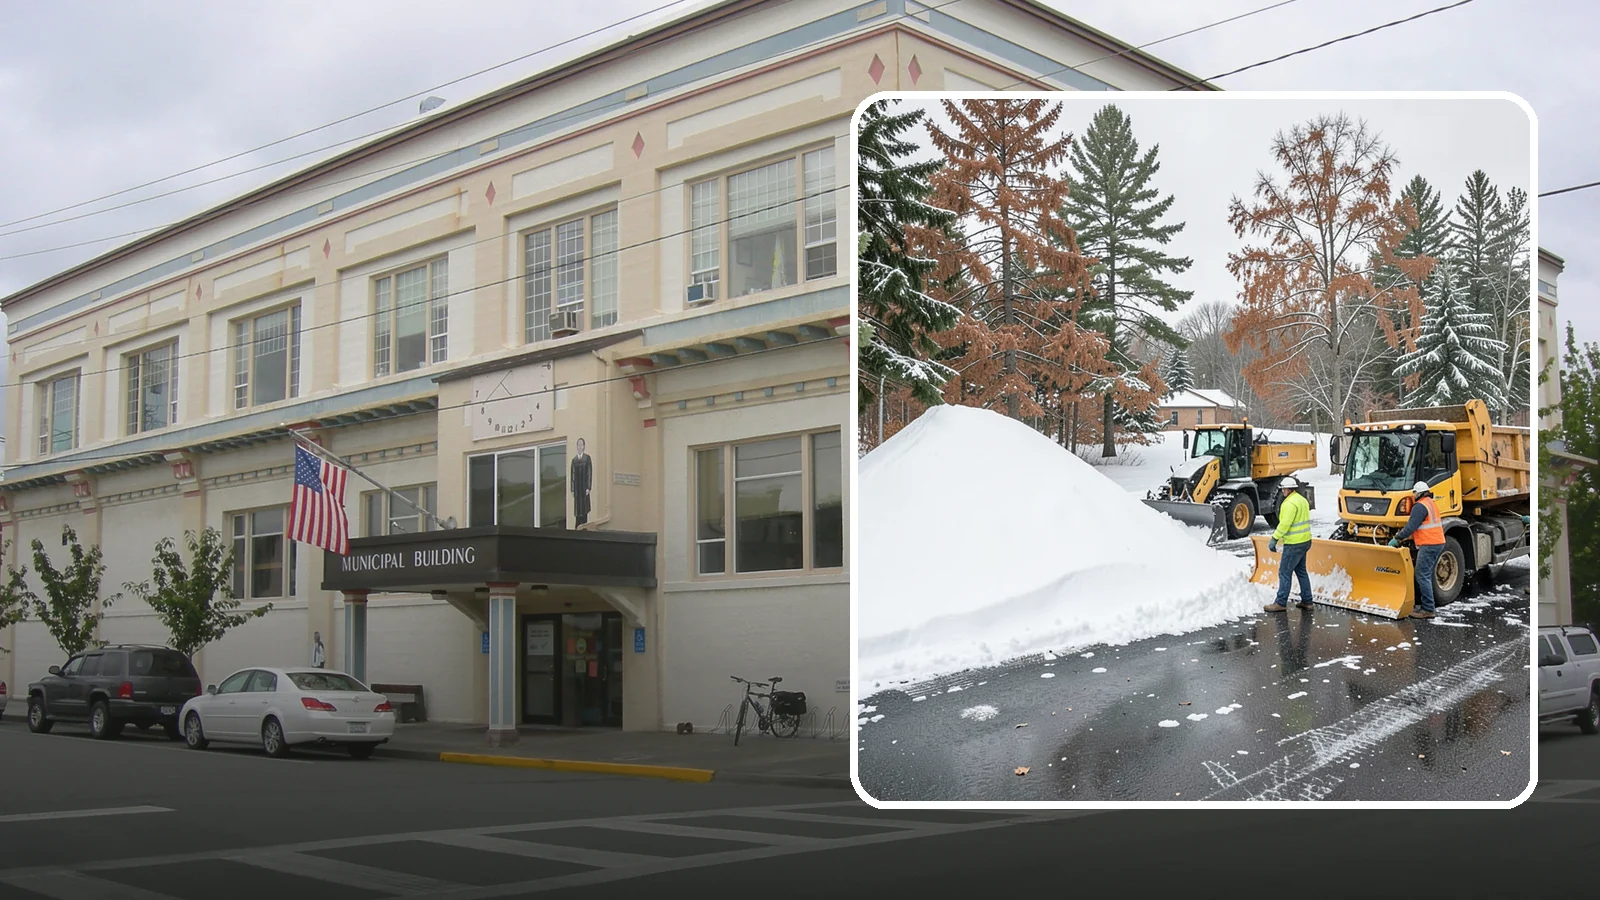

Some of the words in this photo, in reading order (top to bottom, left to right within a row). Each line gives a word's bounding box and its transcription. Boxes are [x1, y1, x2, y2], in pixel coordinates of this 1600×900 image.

[536, 402, 540, 410] 4
[480, 407, 485, 415] 8
[487, 417, 492, 426] 9
[528, 414, 533, 422] 3
[494, 423, 500, 432] 10
[521, 420, 526, 428] 2
[501, 425, 506, 433] 11
[507, 425, 513, 433] 12
[342, 552, 405, 572] MUNICIPAL
[414, 546, 475, 567] BUILDING
